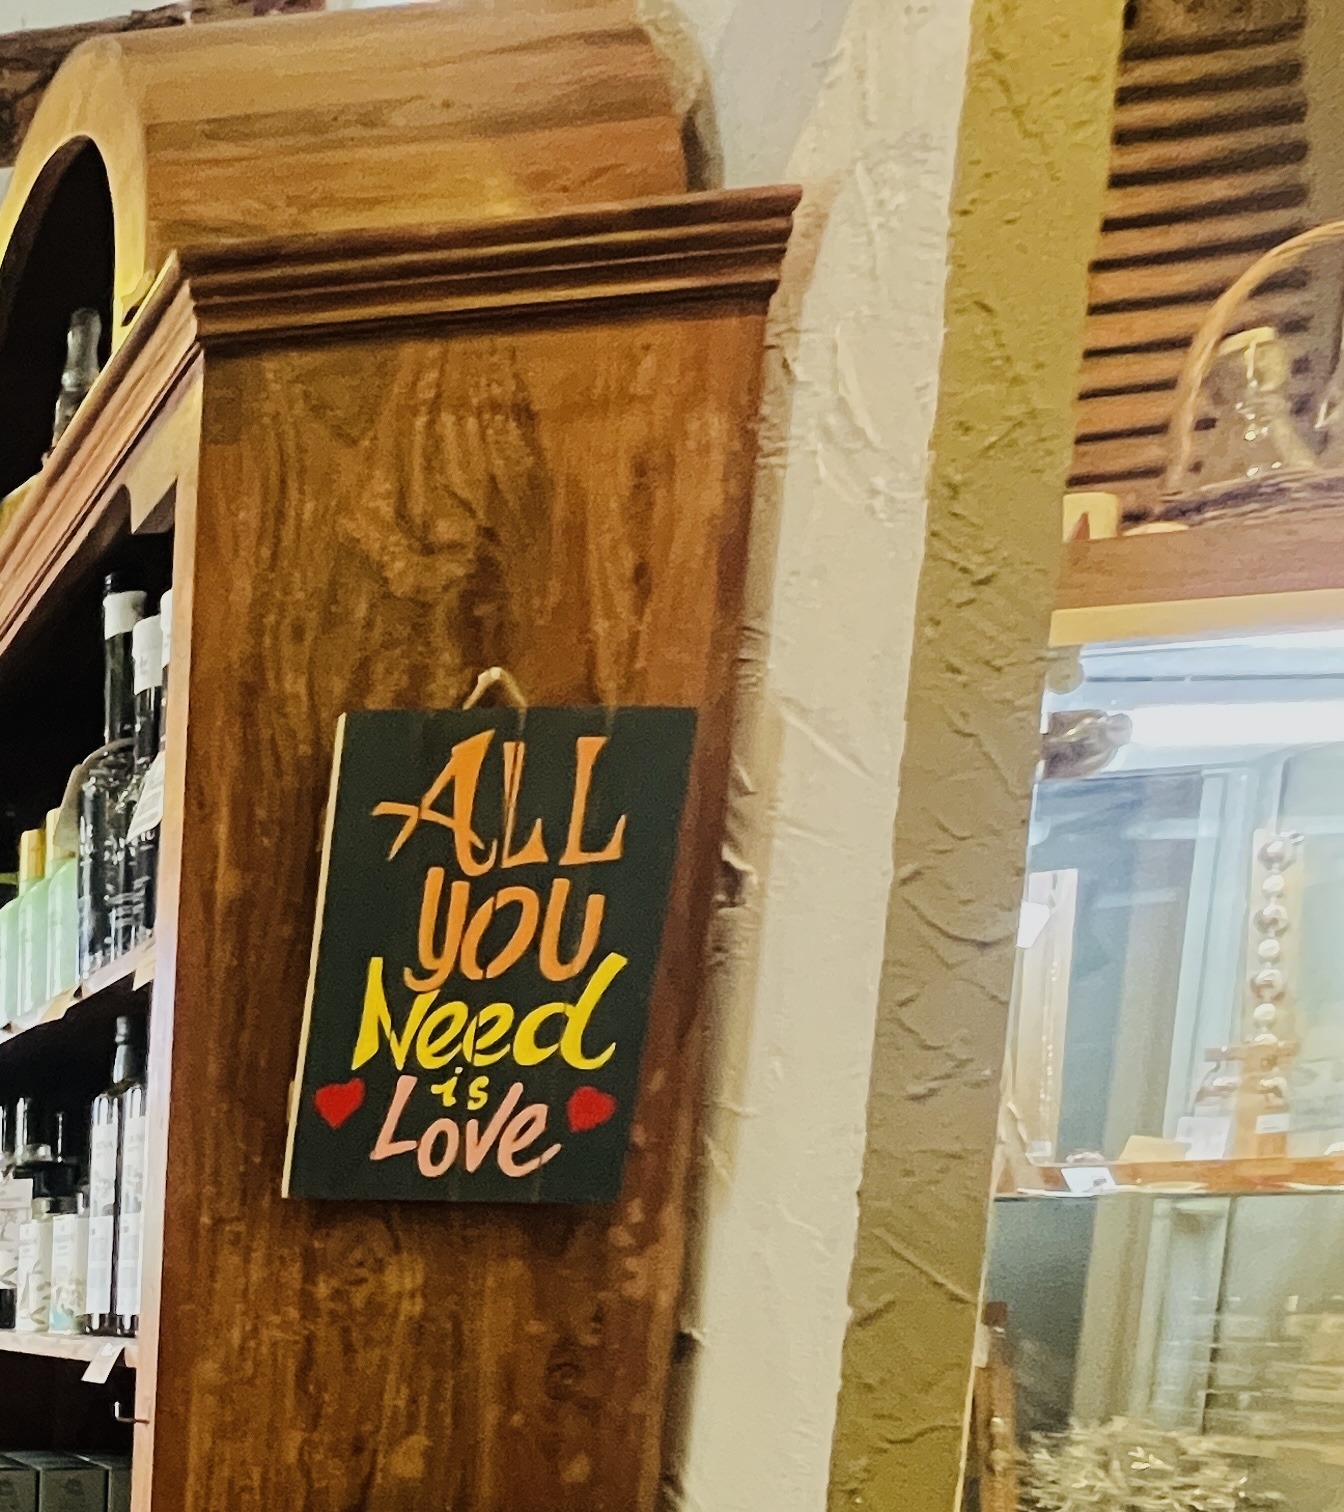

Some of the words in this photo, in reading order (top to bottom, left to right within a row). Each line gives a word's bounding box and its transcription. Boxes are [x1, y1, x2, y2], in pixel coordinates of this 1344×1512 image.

[371, 728, 627, 878] ALL
[351, 952, 629, 1071] Need
[370, 1075, 563, 1178] Love
[430, 1066, 489, 1111] is
